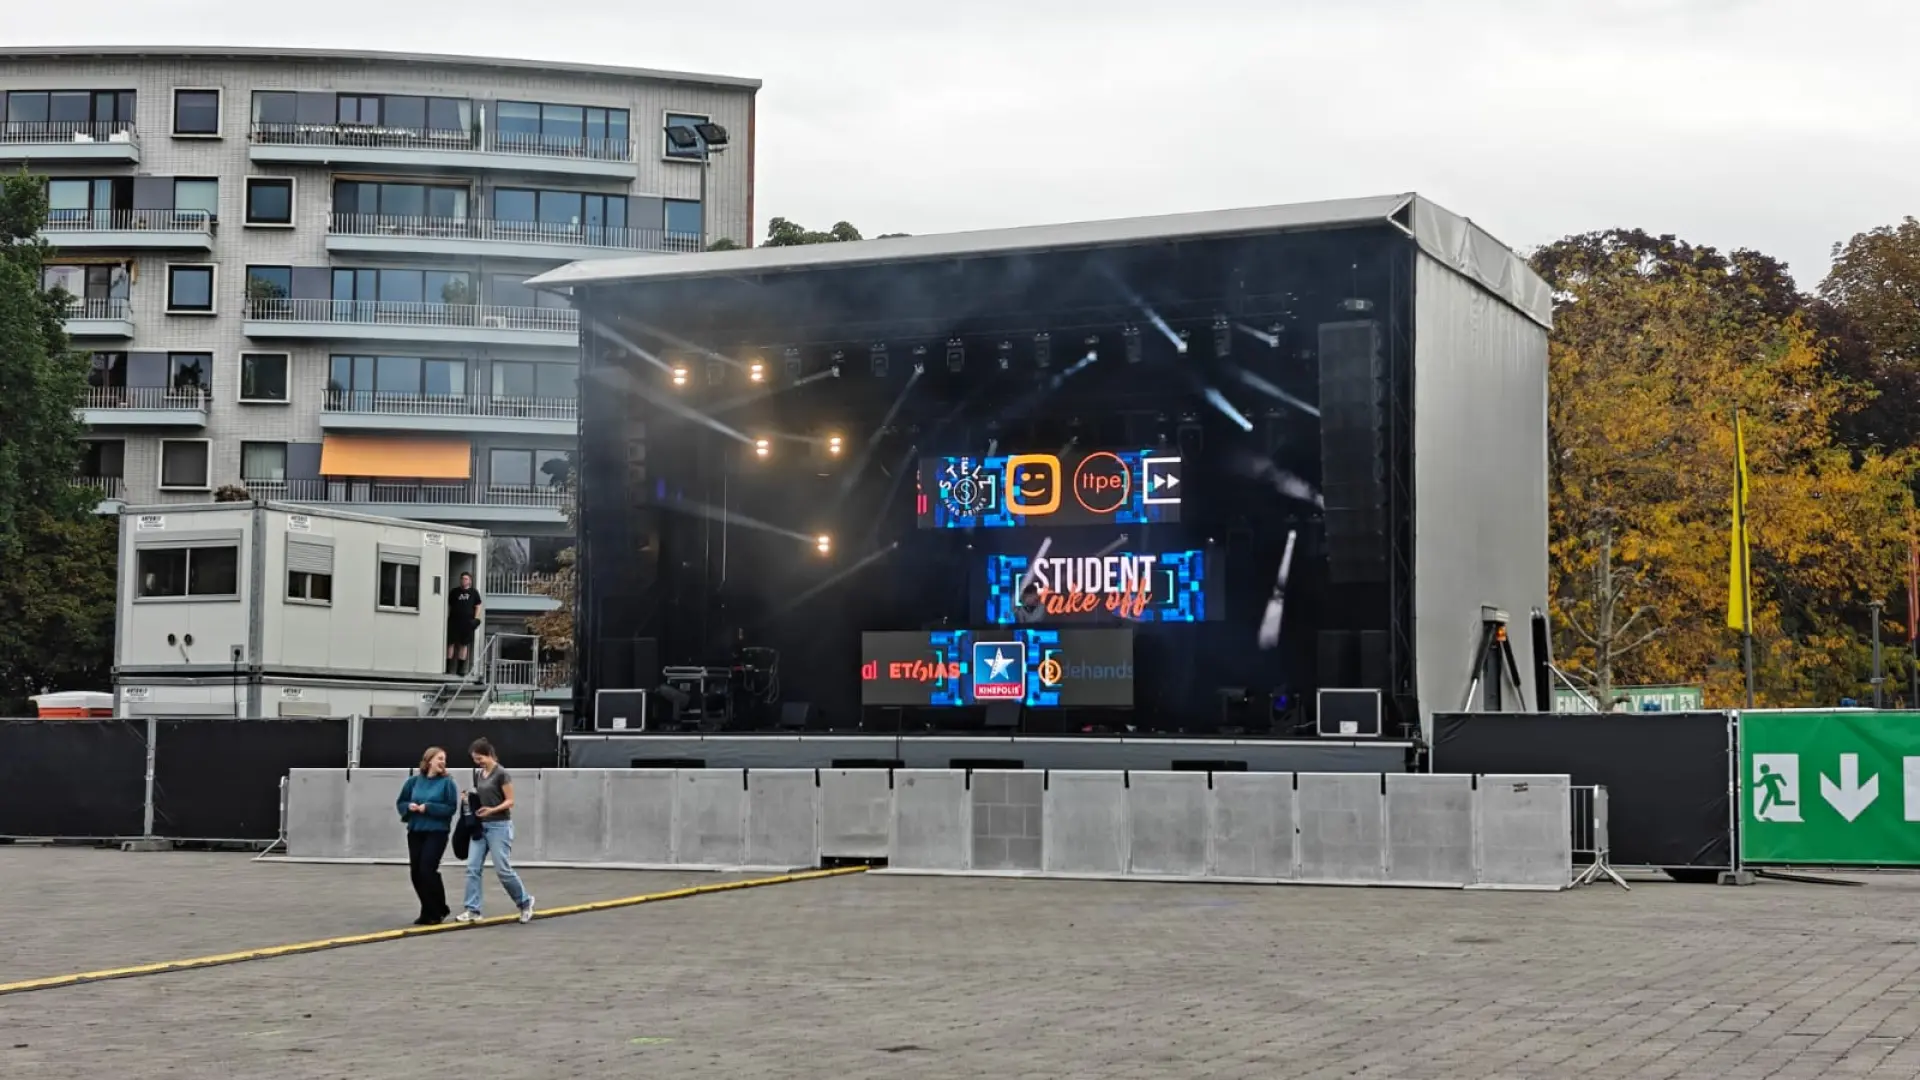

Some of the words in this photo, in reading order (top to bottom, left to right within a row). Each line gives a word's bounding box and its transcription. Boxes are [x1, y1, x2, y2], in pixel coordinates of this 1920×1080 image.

[1032, 555, 1156, 595] STUDENT
[1106, 577, 1152, 618] off
[978, 685, 1020, 695] KINEPOLIS
